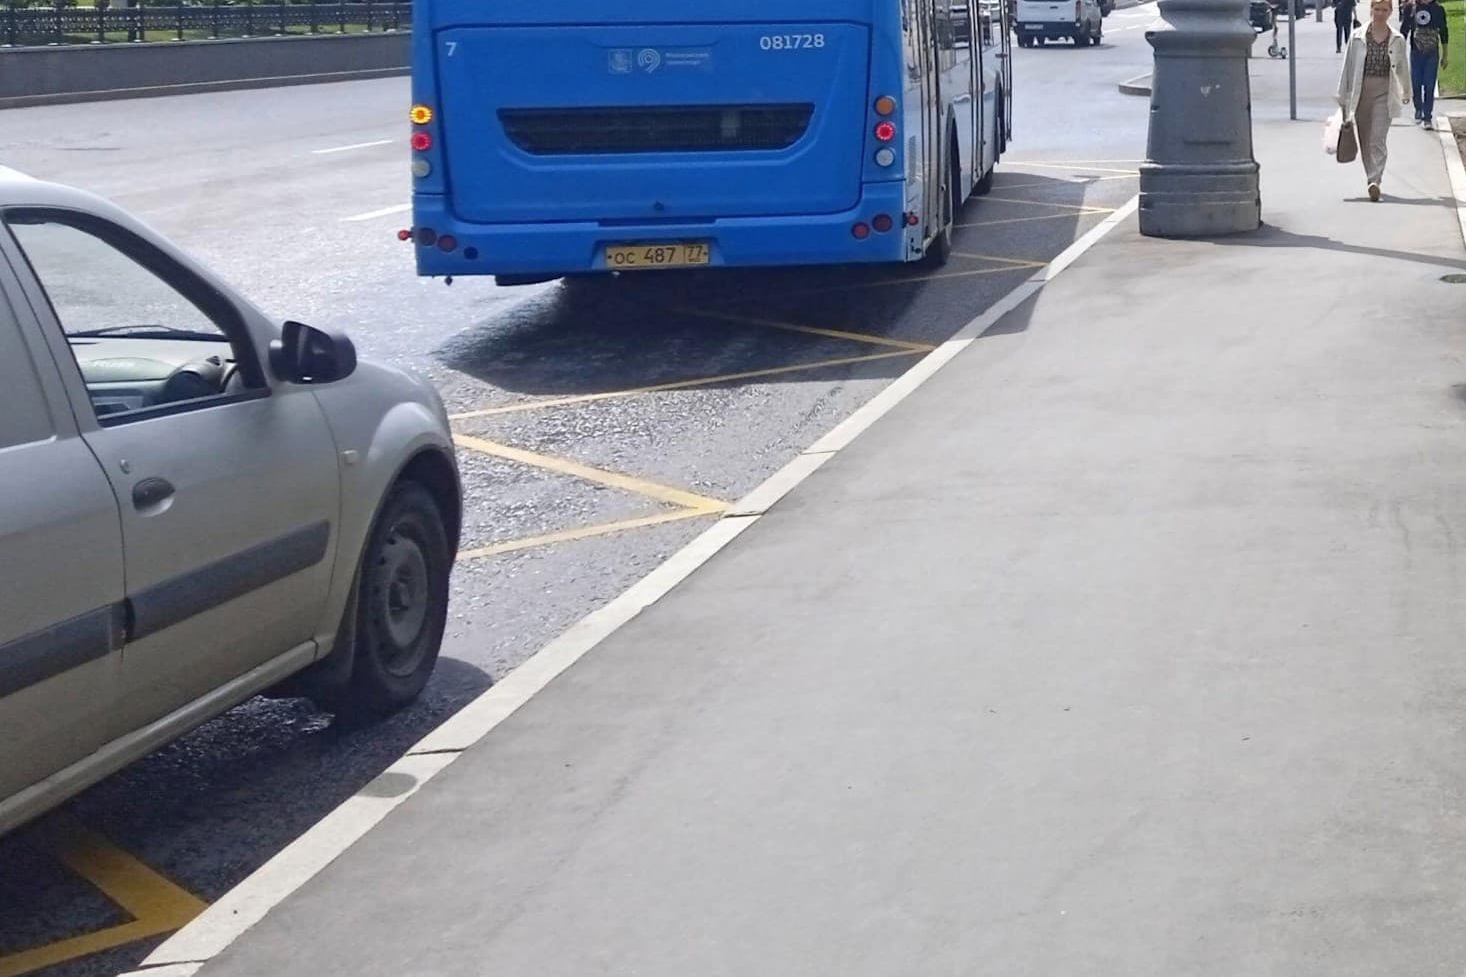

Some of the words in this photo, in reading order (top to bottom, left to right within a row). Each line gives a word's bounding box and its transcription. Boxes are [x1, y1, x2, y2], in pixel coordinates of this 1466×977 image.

[444, 41, 458, 57] 7
[759, 33, 826, 51] 081728
[644, 246, 676, 263] 487
